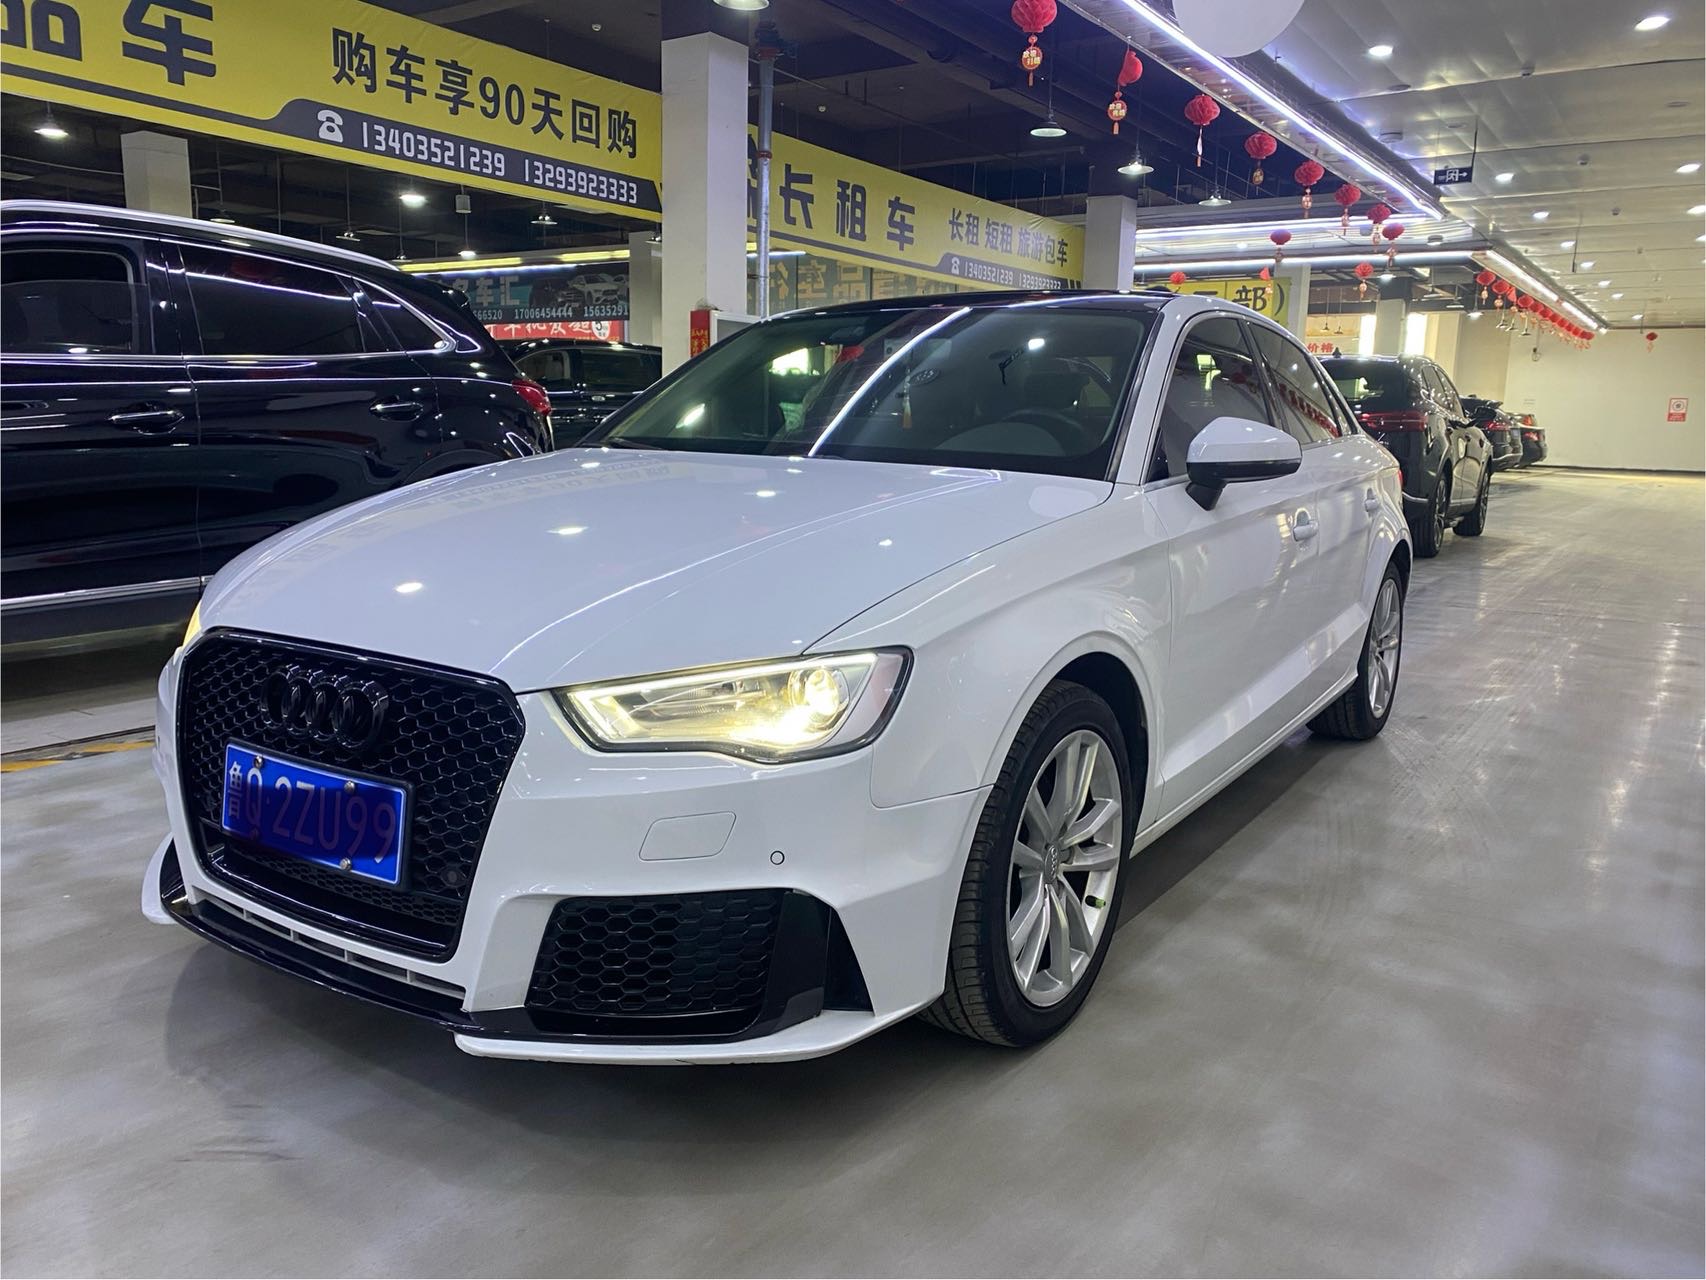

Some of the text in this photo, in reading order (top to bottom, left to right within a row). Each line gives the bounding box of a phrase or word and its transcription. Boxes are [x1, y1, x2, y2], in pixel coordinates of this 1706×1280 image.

[332, 27, 638, 159] 购车享90天回购
[361, 121, 638, 204] 13403521239 13293923333
[949, 208, 1068, 267] 长租 短租 旅游包车
